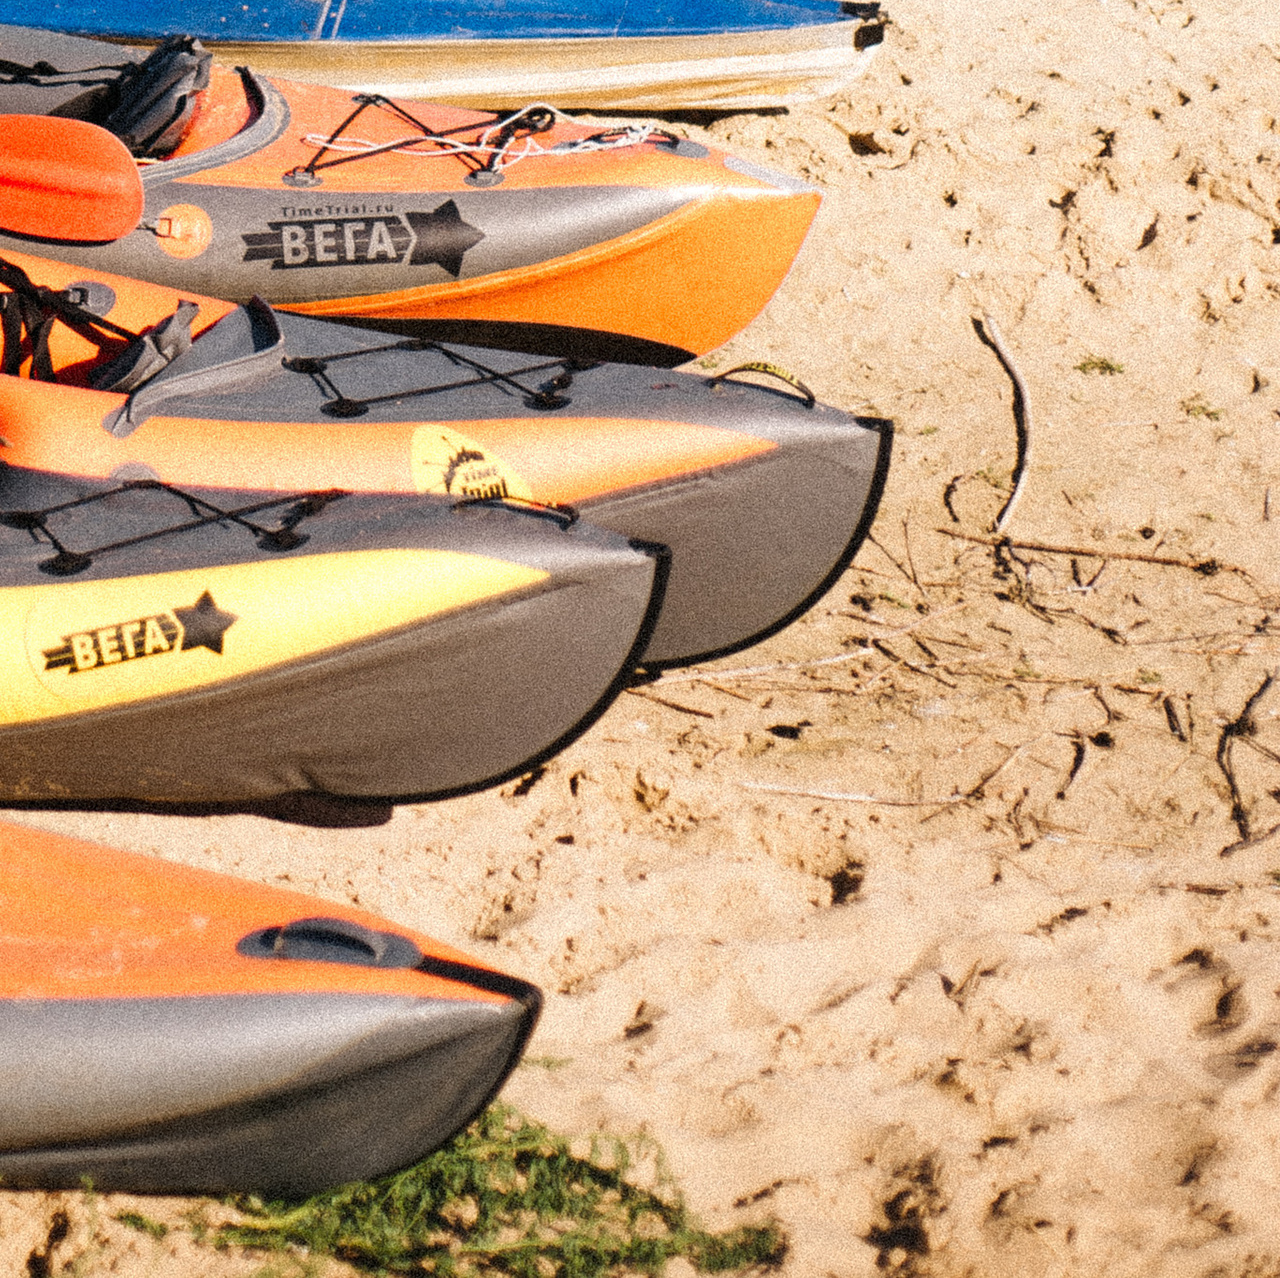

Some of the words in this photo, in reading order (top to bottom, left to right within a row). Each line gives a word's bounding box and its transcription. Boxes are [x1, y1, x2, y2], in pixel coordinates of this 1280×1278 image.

[282, 205, 394, 217] TimeTrial.ru
[282, 221, 397, 264] ВЕГА
[71, 619, 170, 670] ВЕГА
